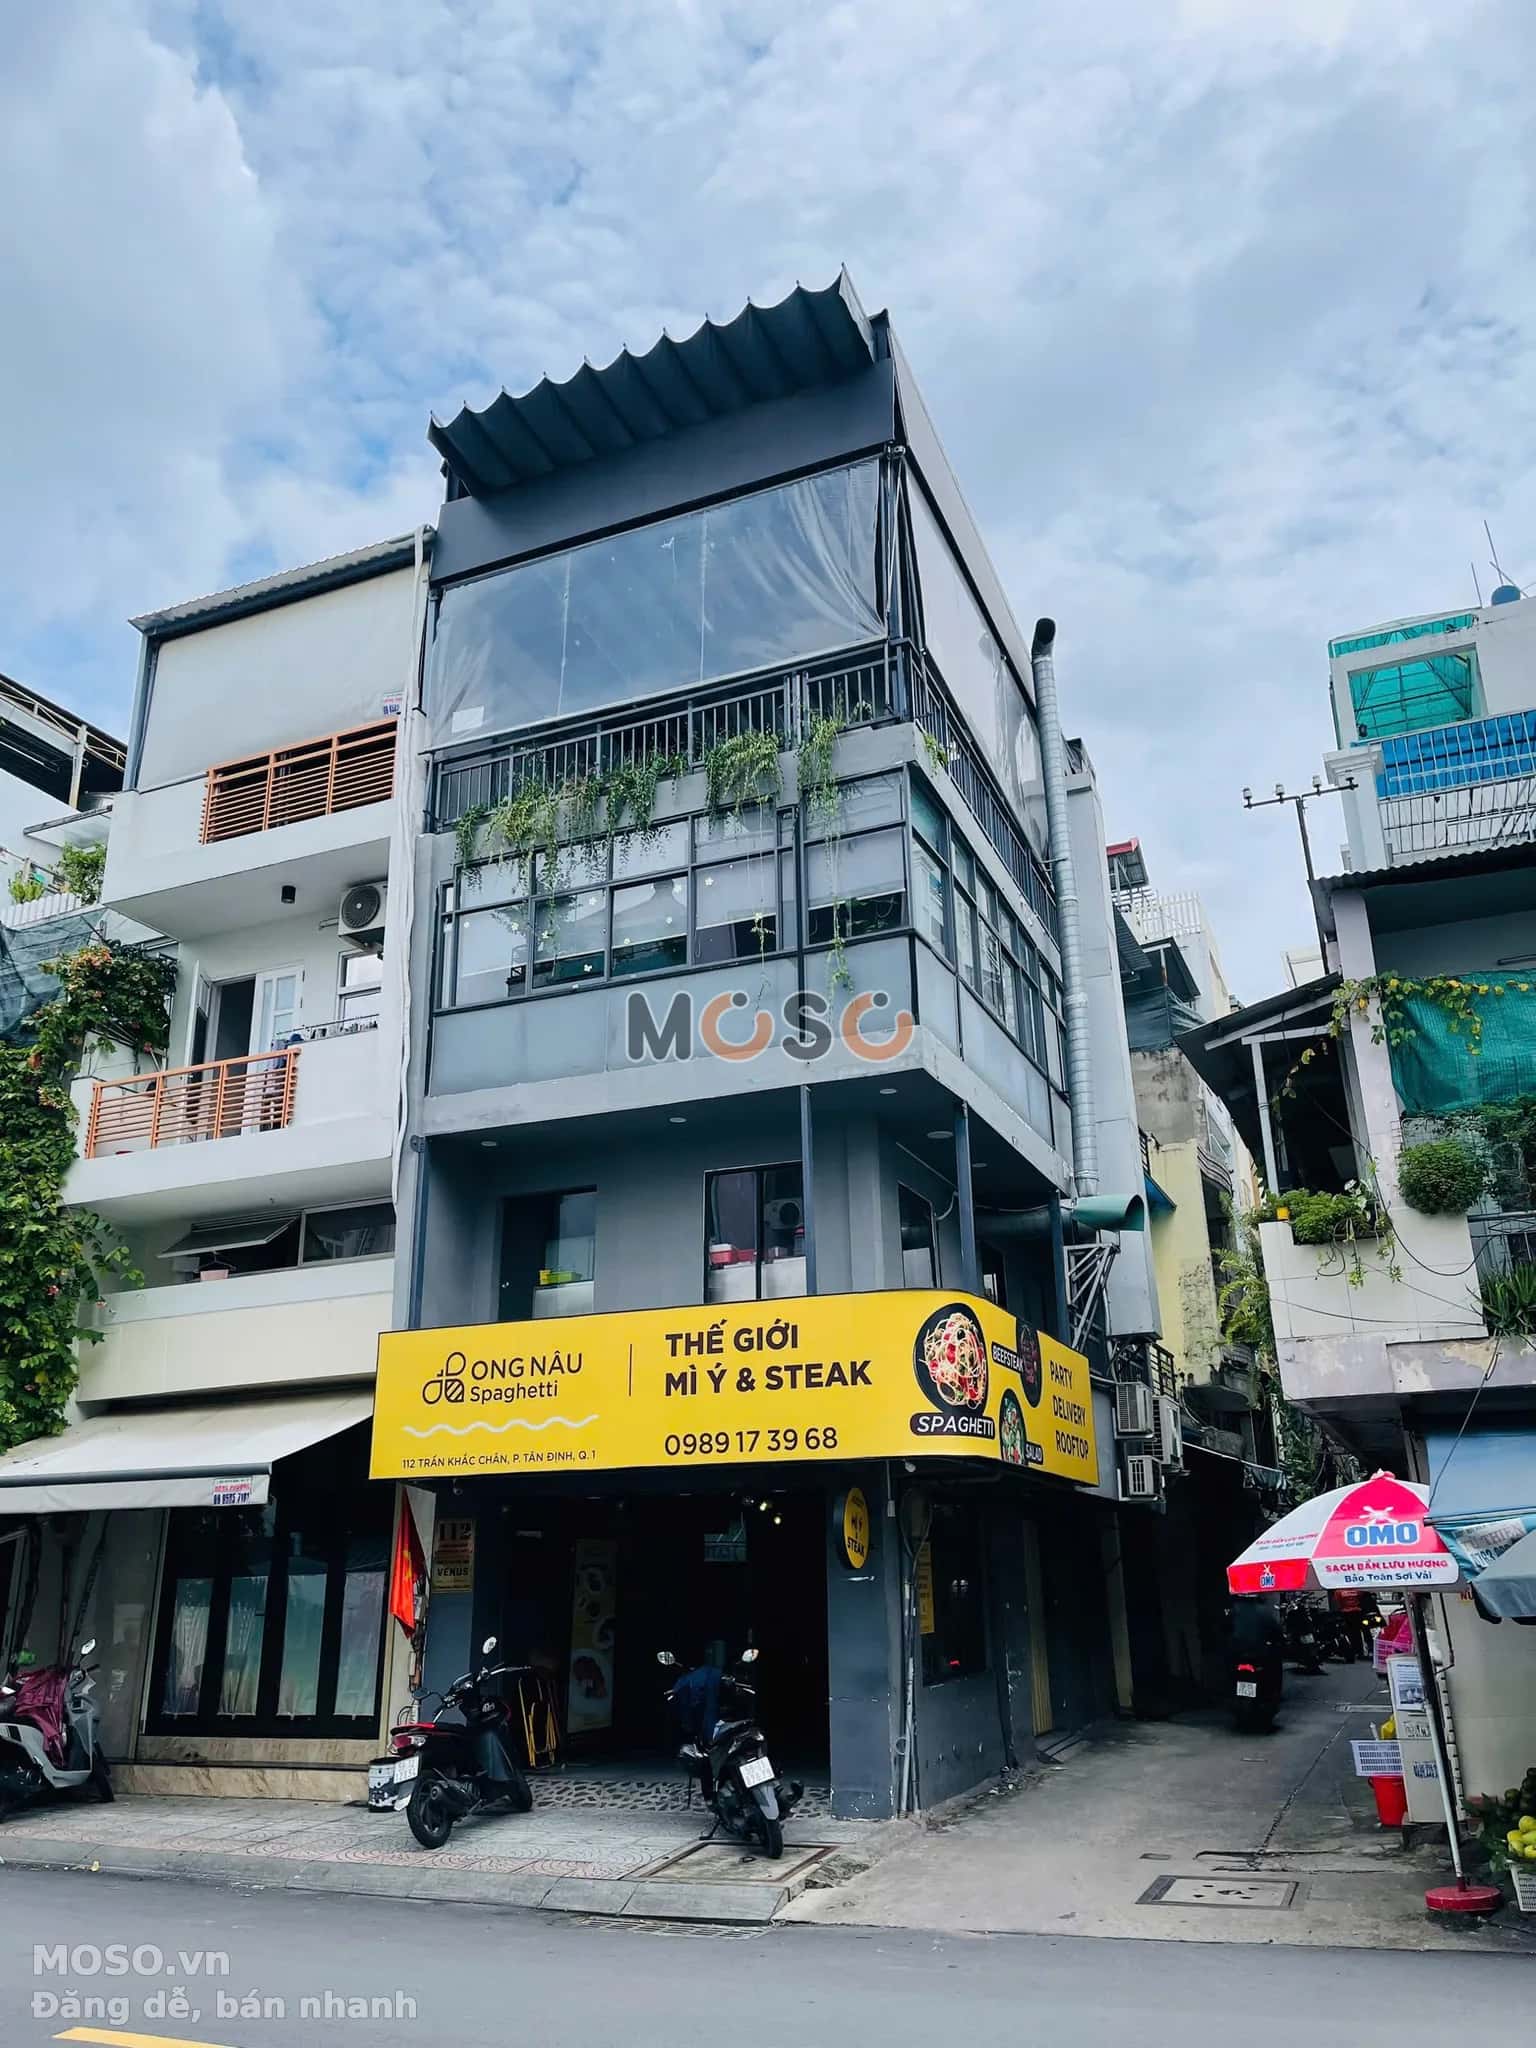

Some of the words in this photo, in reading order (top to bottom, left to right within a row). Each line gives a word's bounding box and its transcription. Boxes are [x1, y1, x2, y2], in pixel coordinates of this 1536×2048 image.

[665, 1319, 727, 1357] THẾ
[733, 1319, 798, 1353] GIỚI
[471, 1357, 524, 1380] ONG
[529, 1350, 582, 1376] NÂU
[665, 1364, 697, 1396] MÌ
[707, 1362, 728, 1393] Ý
[736, 1367, 756, 1392] &
[765, 1360, 872, 1390] STEAK
[1049, 1360, 1073, 1389] PARTY
[470, 1379, 558, 1404] Spaghetti
[916, 1414, 994, 1437] SPAGHETTI
[1052, 1395, 1086, 1428] DELIVERY
[664, 1431, 730, 1456] 0989
[735, 1430, 760, 1453] 17
[767, 1428, 797, 1451] 39
[804, 1426, 837, 1450] 68
[1025, 1443, 1042, 1462] SALAD
[1056, 1430, 1089, 1461] ROOFTOP
[402, 1459, 416, 1469] 112
[523, 1451, 544, 1462] TÂN
[1345, 1521, 1419, 1547] OMO
[437, 1567, 469, 1577] VENUS
